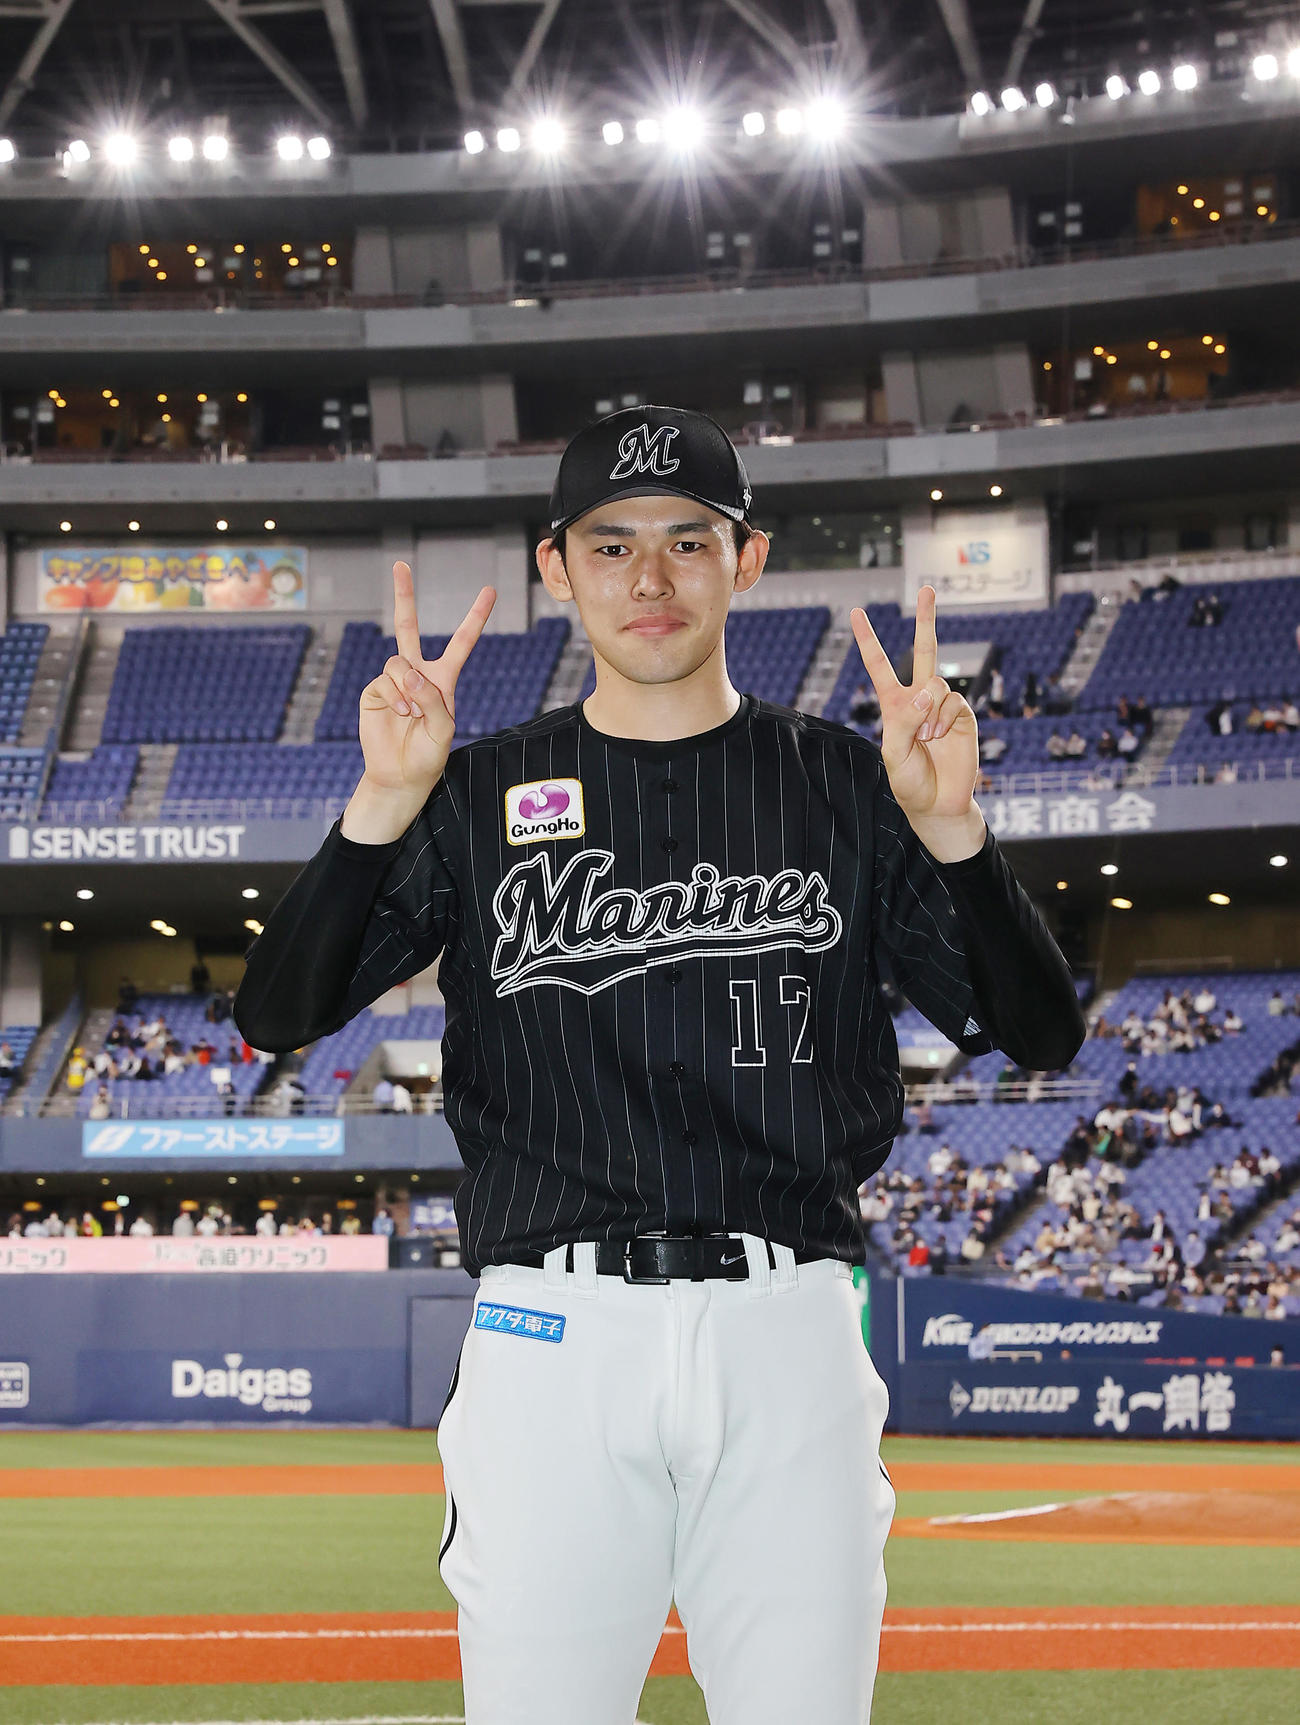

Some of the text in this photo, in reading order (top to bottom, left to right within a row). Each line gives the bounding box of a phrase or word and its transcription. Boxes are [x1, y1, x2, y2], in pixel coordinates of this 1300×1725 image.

[609, 423, 680, 479] M
[511, 818, 580, 838] GungHo
[982, 792, 1156, 835] 塚商会
[31, 825, 246, 858] SENSE TRUST
[491, 848, 843, 980] Marines
[729, 975, 814, 1067] 17
[139, 1125, 341, 1151] ファーストステージ
[478, 1306, 562, 1336] フクダ電子
[171, 1353, 312, 1405] Daigas
[969, 1386, 1080, 1413] DUNLOP
